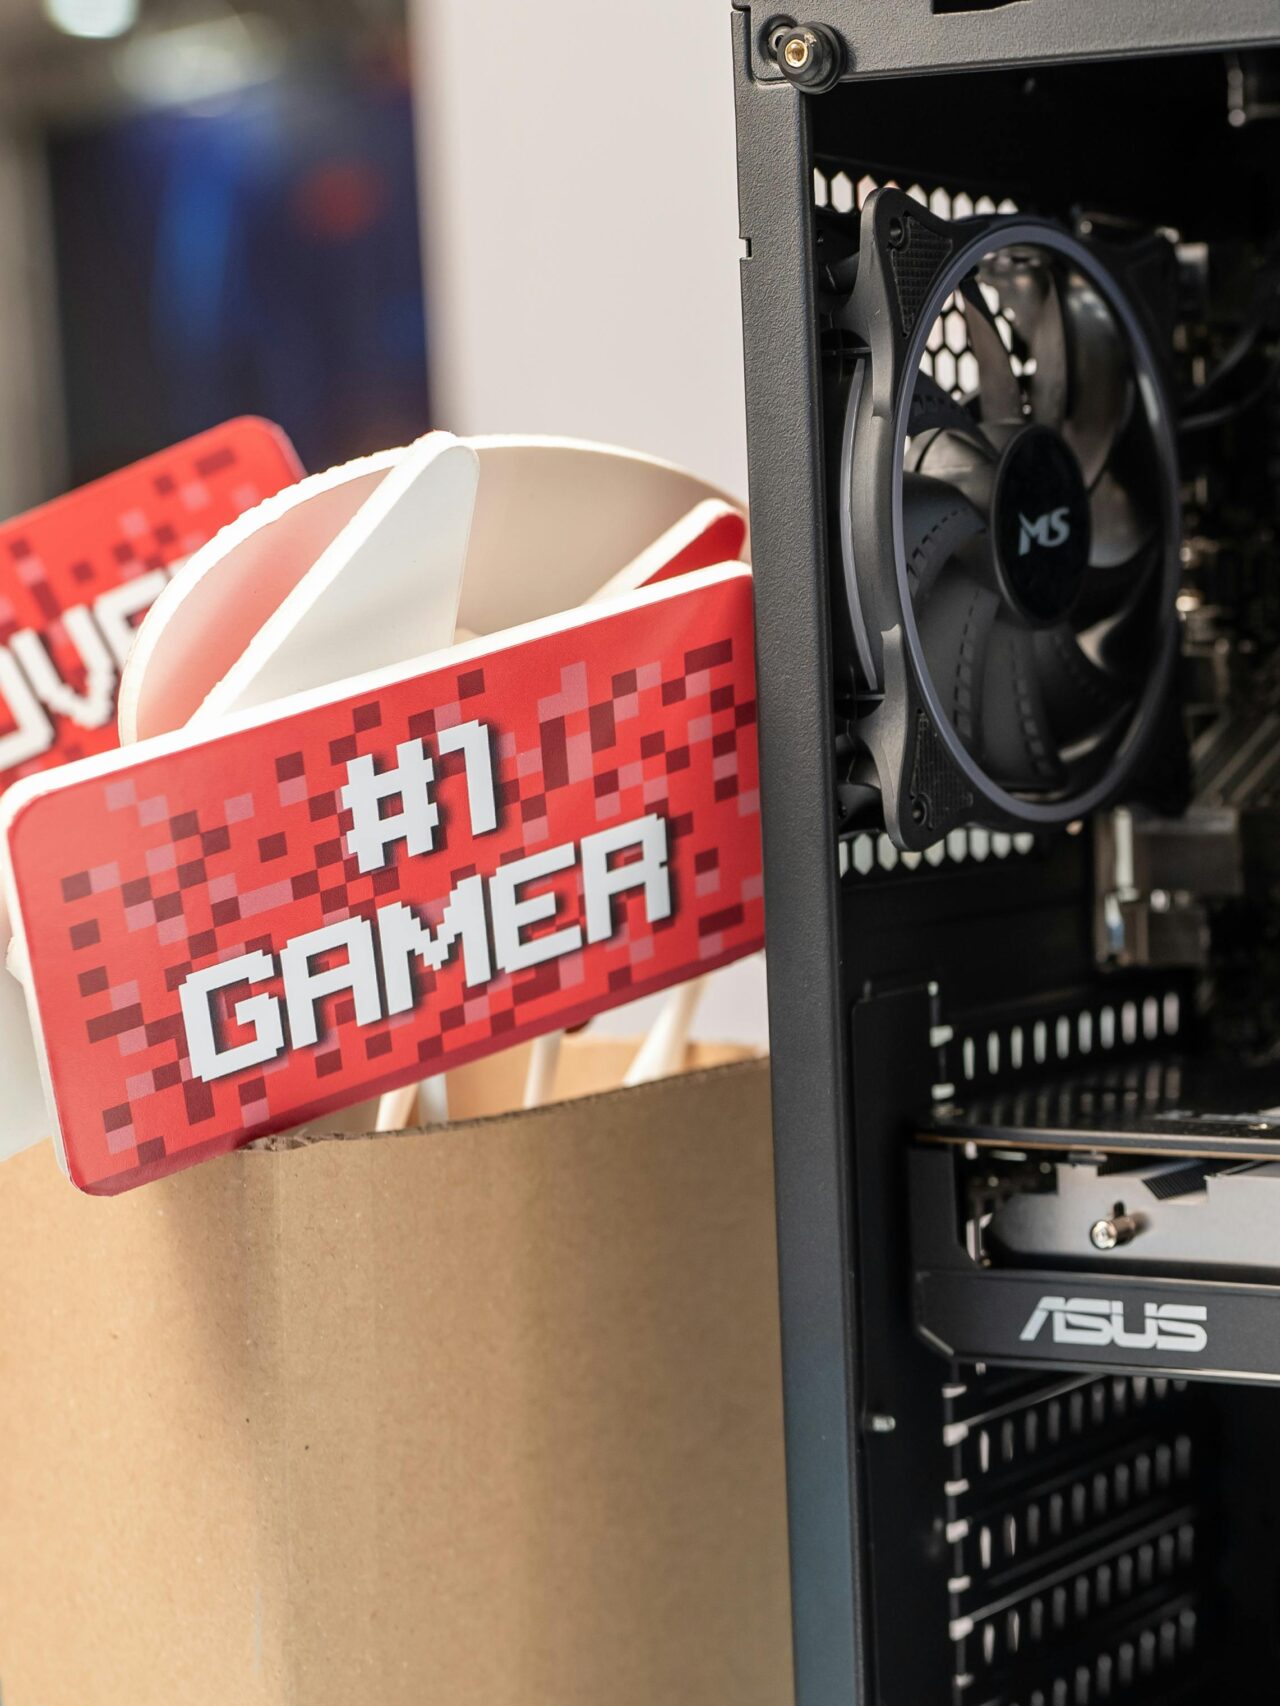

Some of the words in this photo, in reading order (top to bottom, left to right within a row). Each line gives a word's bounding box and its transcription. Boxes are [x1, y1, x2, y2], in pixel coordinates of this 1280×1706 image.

[342, 719, 498, 873] #1
[178, 813, 672, 1083] GAMER
[1019, 1296, 1208, 1352] ASUS
